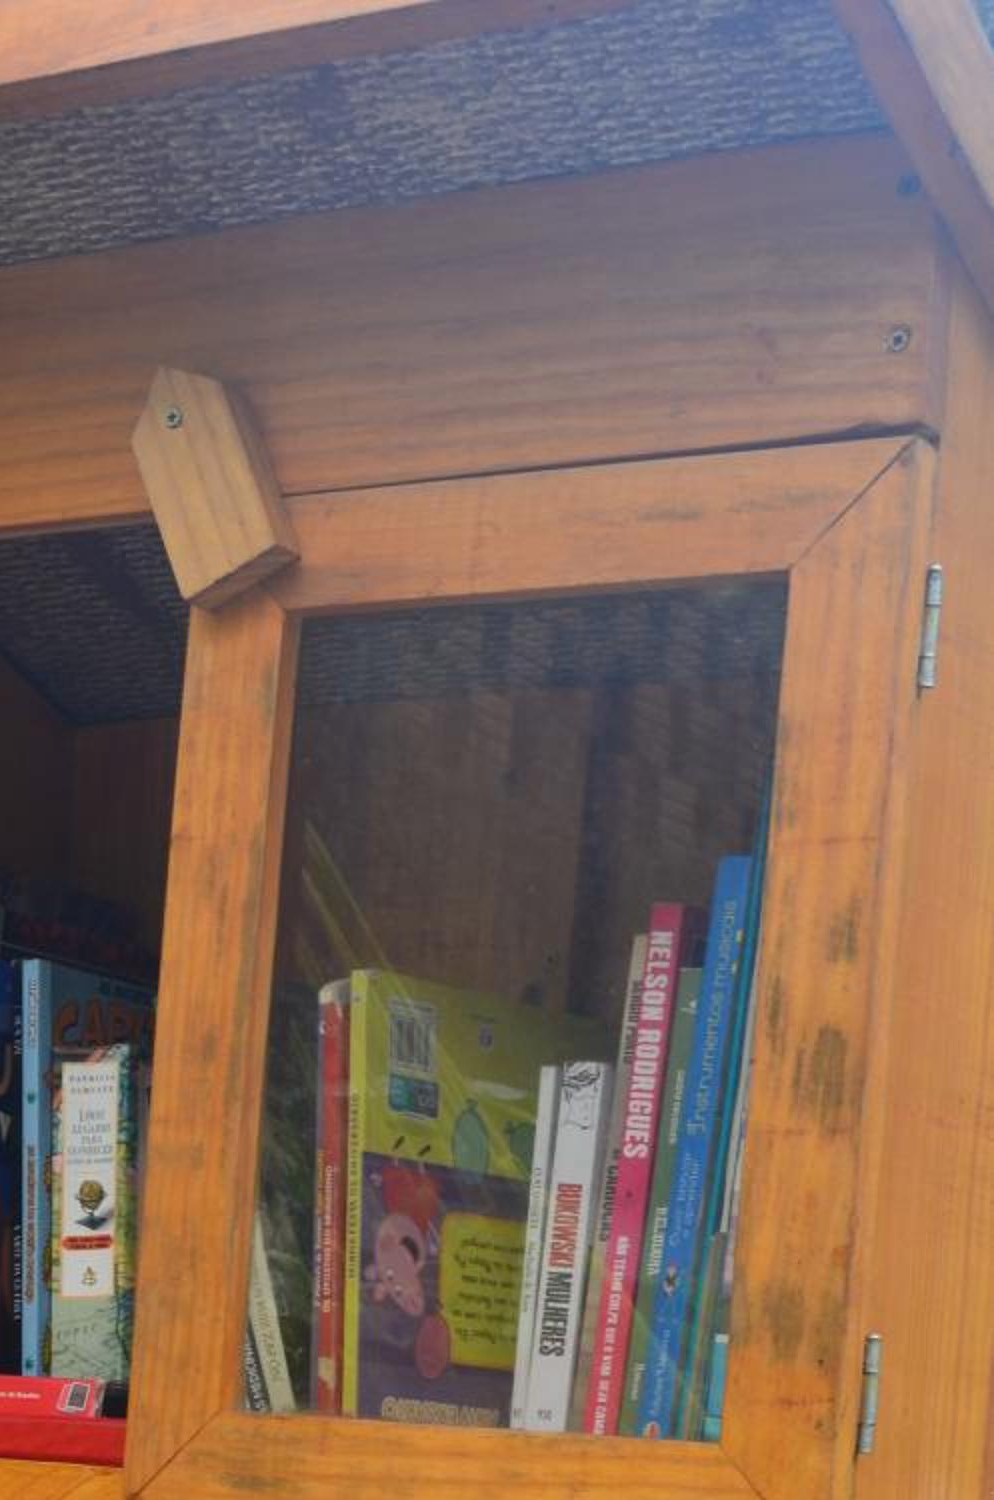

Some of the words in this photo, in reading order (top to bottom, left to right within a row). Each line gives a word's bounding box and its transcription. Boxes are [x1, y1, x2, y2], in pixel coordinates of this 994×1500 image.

[640, 928, 671, 1022] NELSON
[622, 1026, 659, 1160] RODRIGUES
[548, 1179, 583, 1270] BUKOWSKI
[538, 1269, 572, 1358] MULHERES
